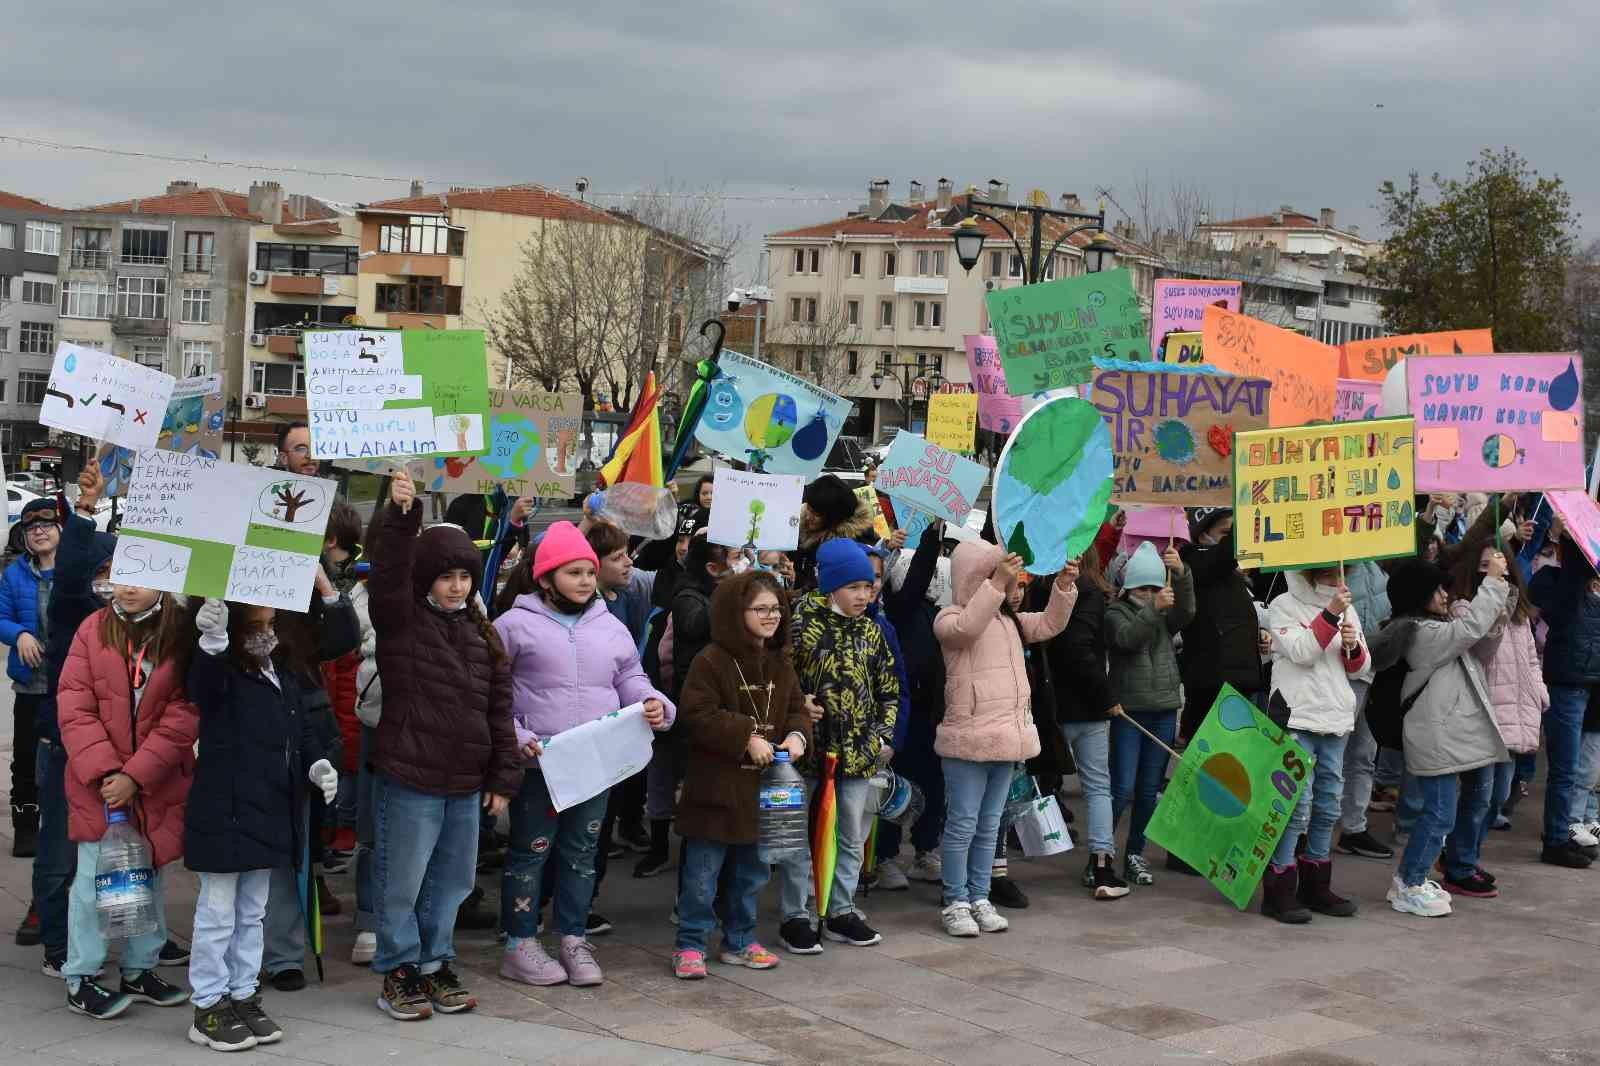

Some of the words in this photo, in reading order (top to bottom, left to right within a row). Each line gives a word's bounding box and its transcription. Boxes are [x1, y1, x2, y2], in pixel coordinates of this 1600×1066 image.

[1420, 372, 1479, 397] SUYU
[1500, 373, 1549, 394] KORU
[512, 393, 564, 411] VARSA
[313, 410, 358, 423] SUYU
[1423, 402, 1483, 422] HAYATI
[1495, 407, 1542, 425] KORU
[496, 446, 511, 457] SU
[919, 445, 956, 474] SU
[535, 481, 573, 497] VAR
